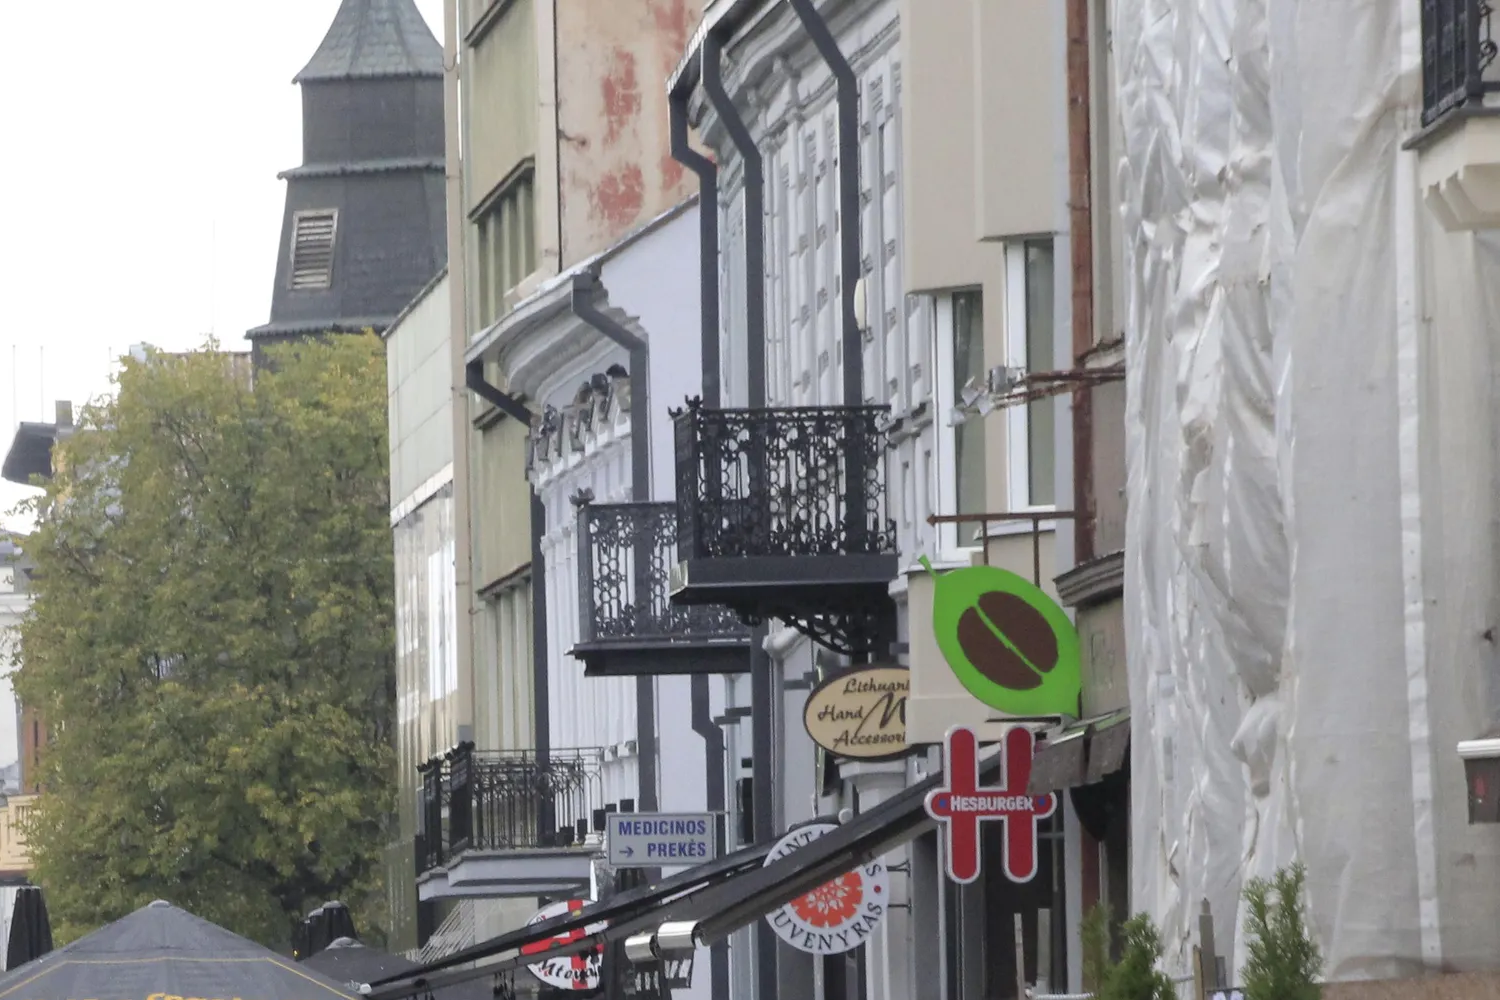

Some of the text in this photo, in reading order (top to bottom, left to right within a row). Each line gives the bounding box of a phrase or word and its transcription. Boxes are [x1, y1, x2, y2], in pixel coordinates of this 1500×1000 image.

[817, 704, 863, 721] Hand
[950, 795, 1034, 812] HESBURGER
[618, 820, 706, 836] MEDICINOS
[647, 838, 706, 857] PREKĖS
[773, 902, 882, 950] UVENYRAS
